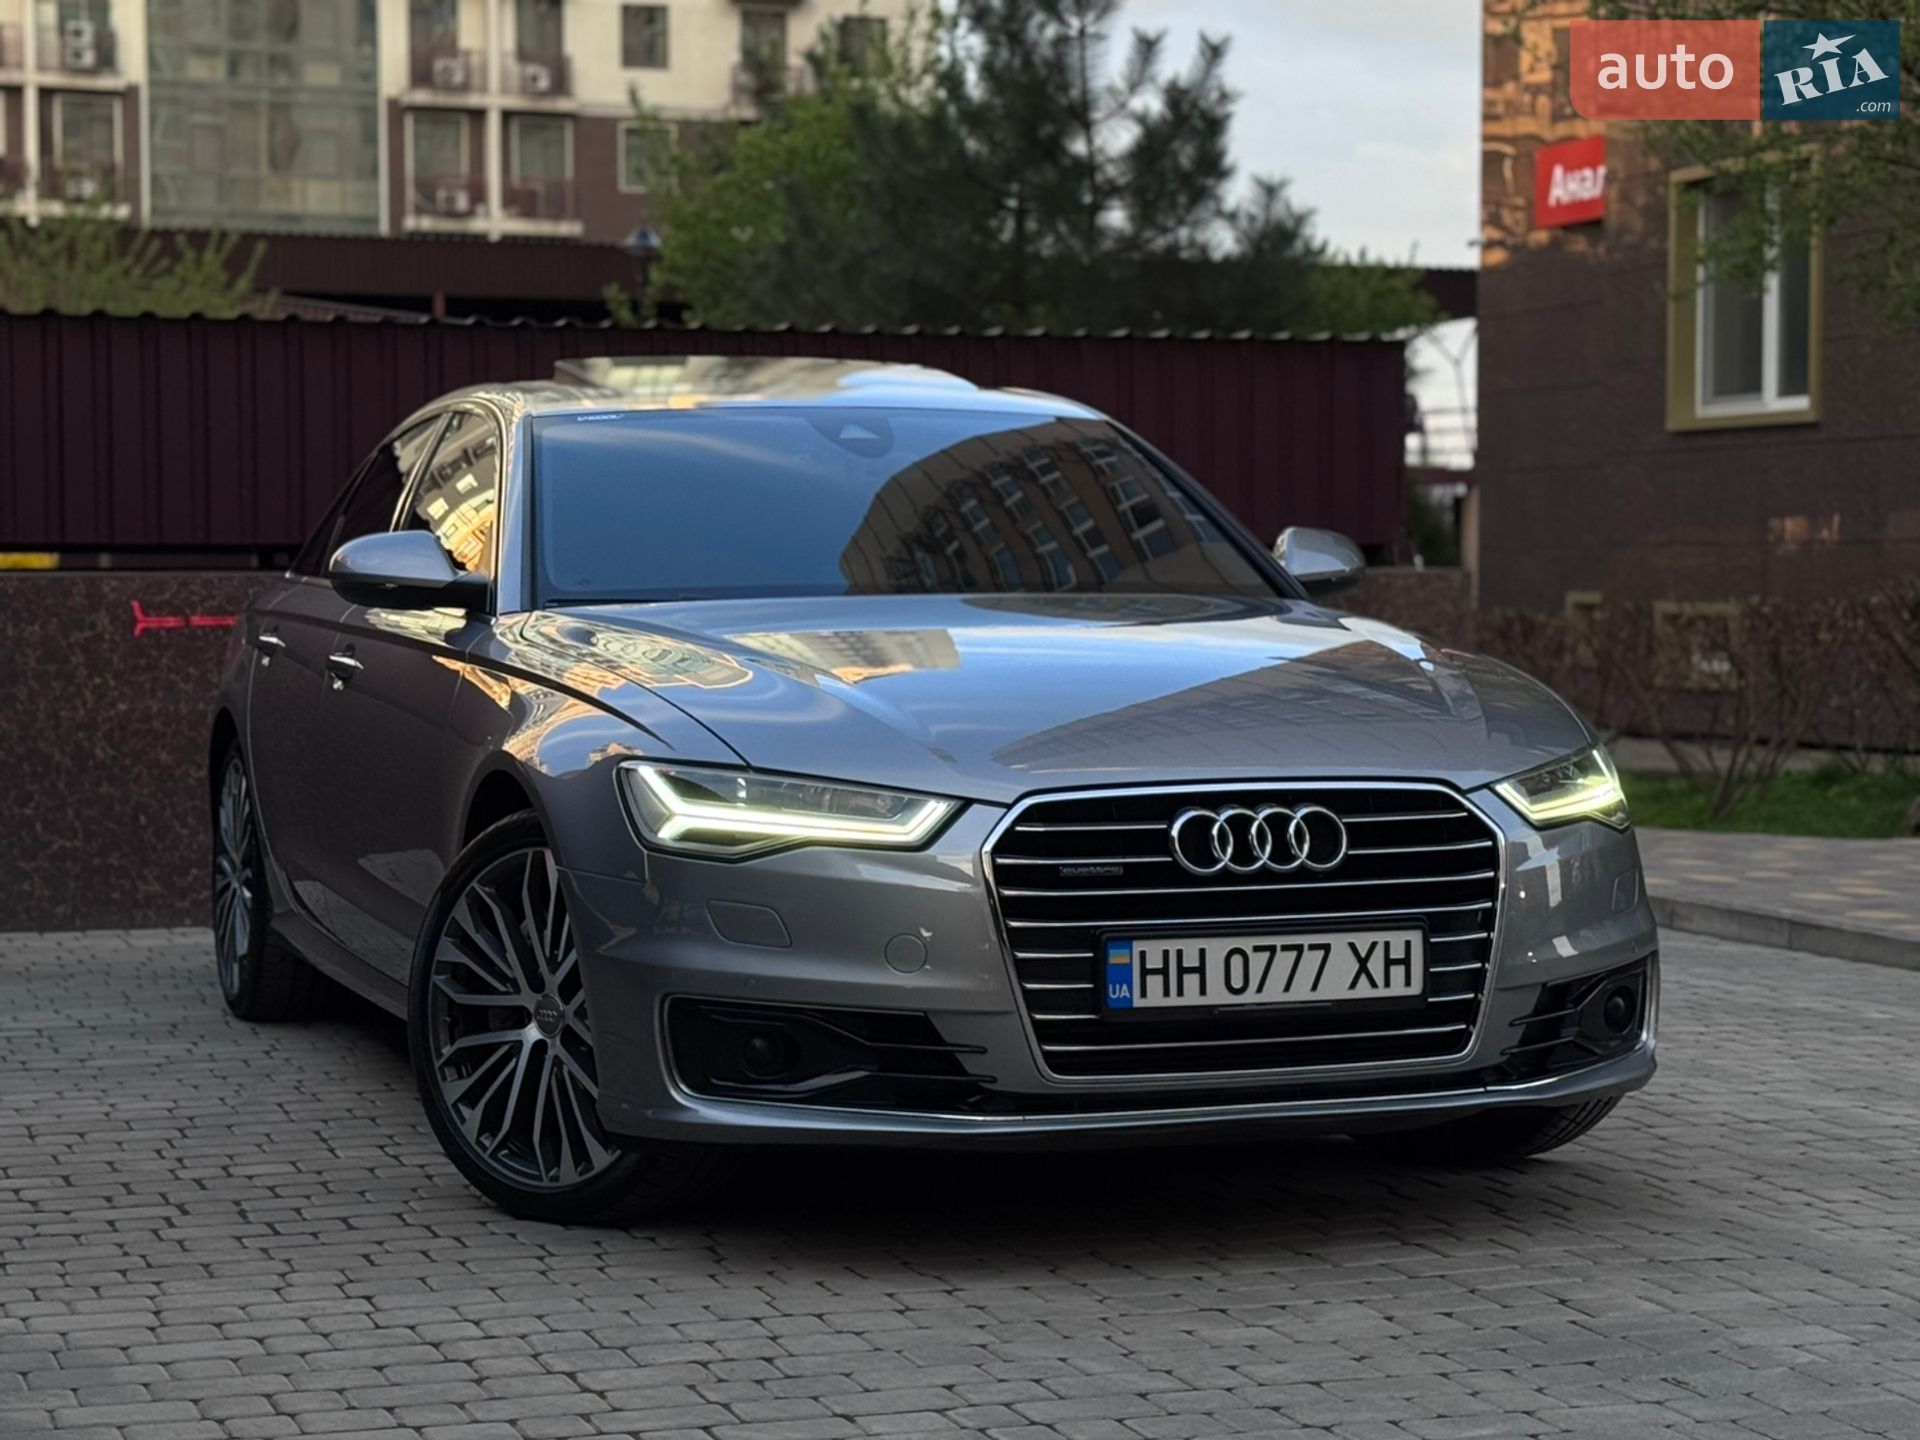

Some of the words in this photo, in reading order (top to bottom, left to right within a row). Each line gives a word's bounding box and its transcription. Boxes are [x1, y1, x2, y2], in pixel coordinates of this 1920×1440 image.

[1139, 948, 1207, 998] HH
[1224, 943, 1332, 995] 0777
[1347, 939, 1412, 990] XH
[1109, 985, 1131, 998] UA
